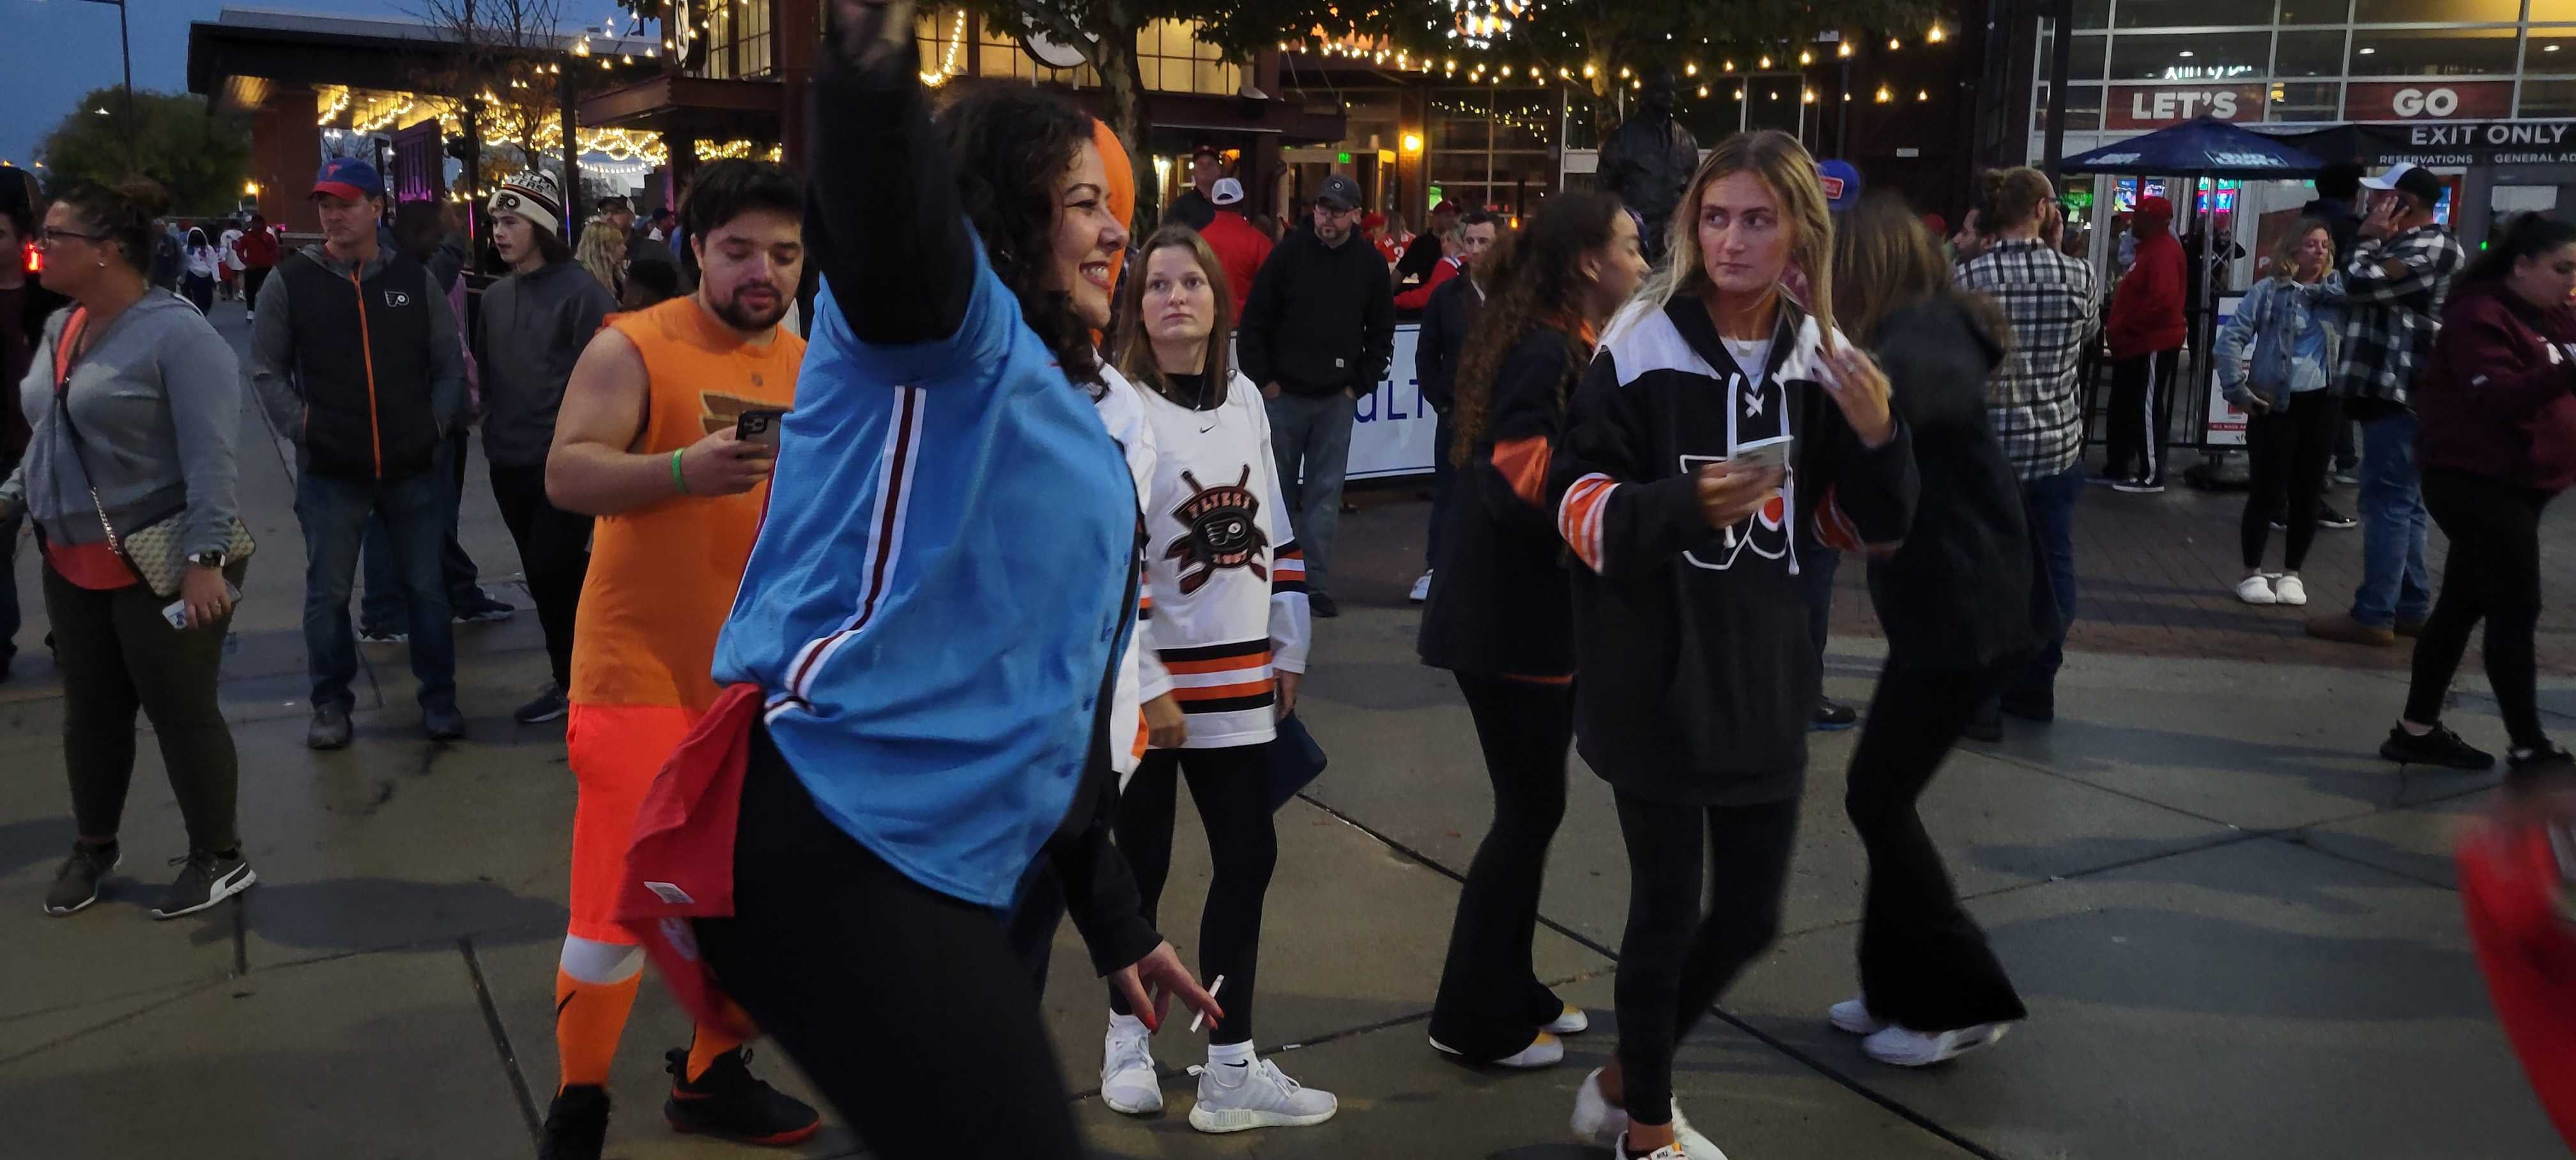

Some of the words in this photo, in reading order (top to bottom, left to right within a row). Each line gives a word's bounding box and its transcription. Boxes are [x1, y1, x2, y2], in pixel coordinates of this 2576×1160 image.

[2132, 91, 2237, 120] LET'S
[2393, 88, 2458, 117] GO
[2411, 126, 2478, 146] EXIT
[2487, 125, 2568, 144] ONLY
[2379, 155, 2473, 164] RESERVATIONS
[2495, 153, 2554, 164] GENERAL
